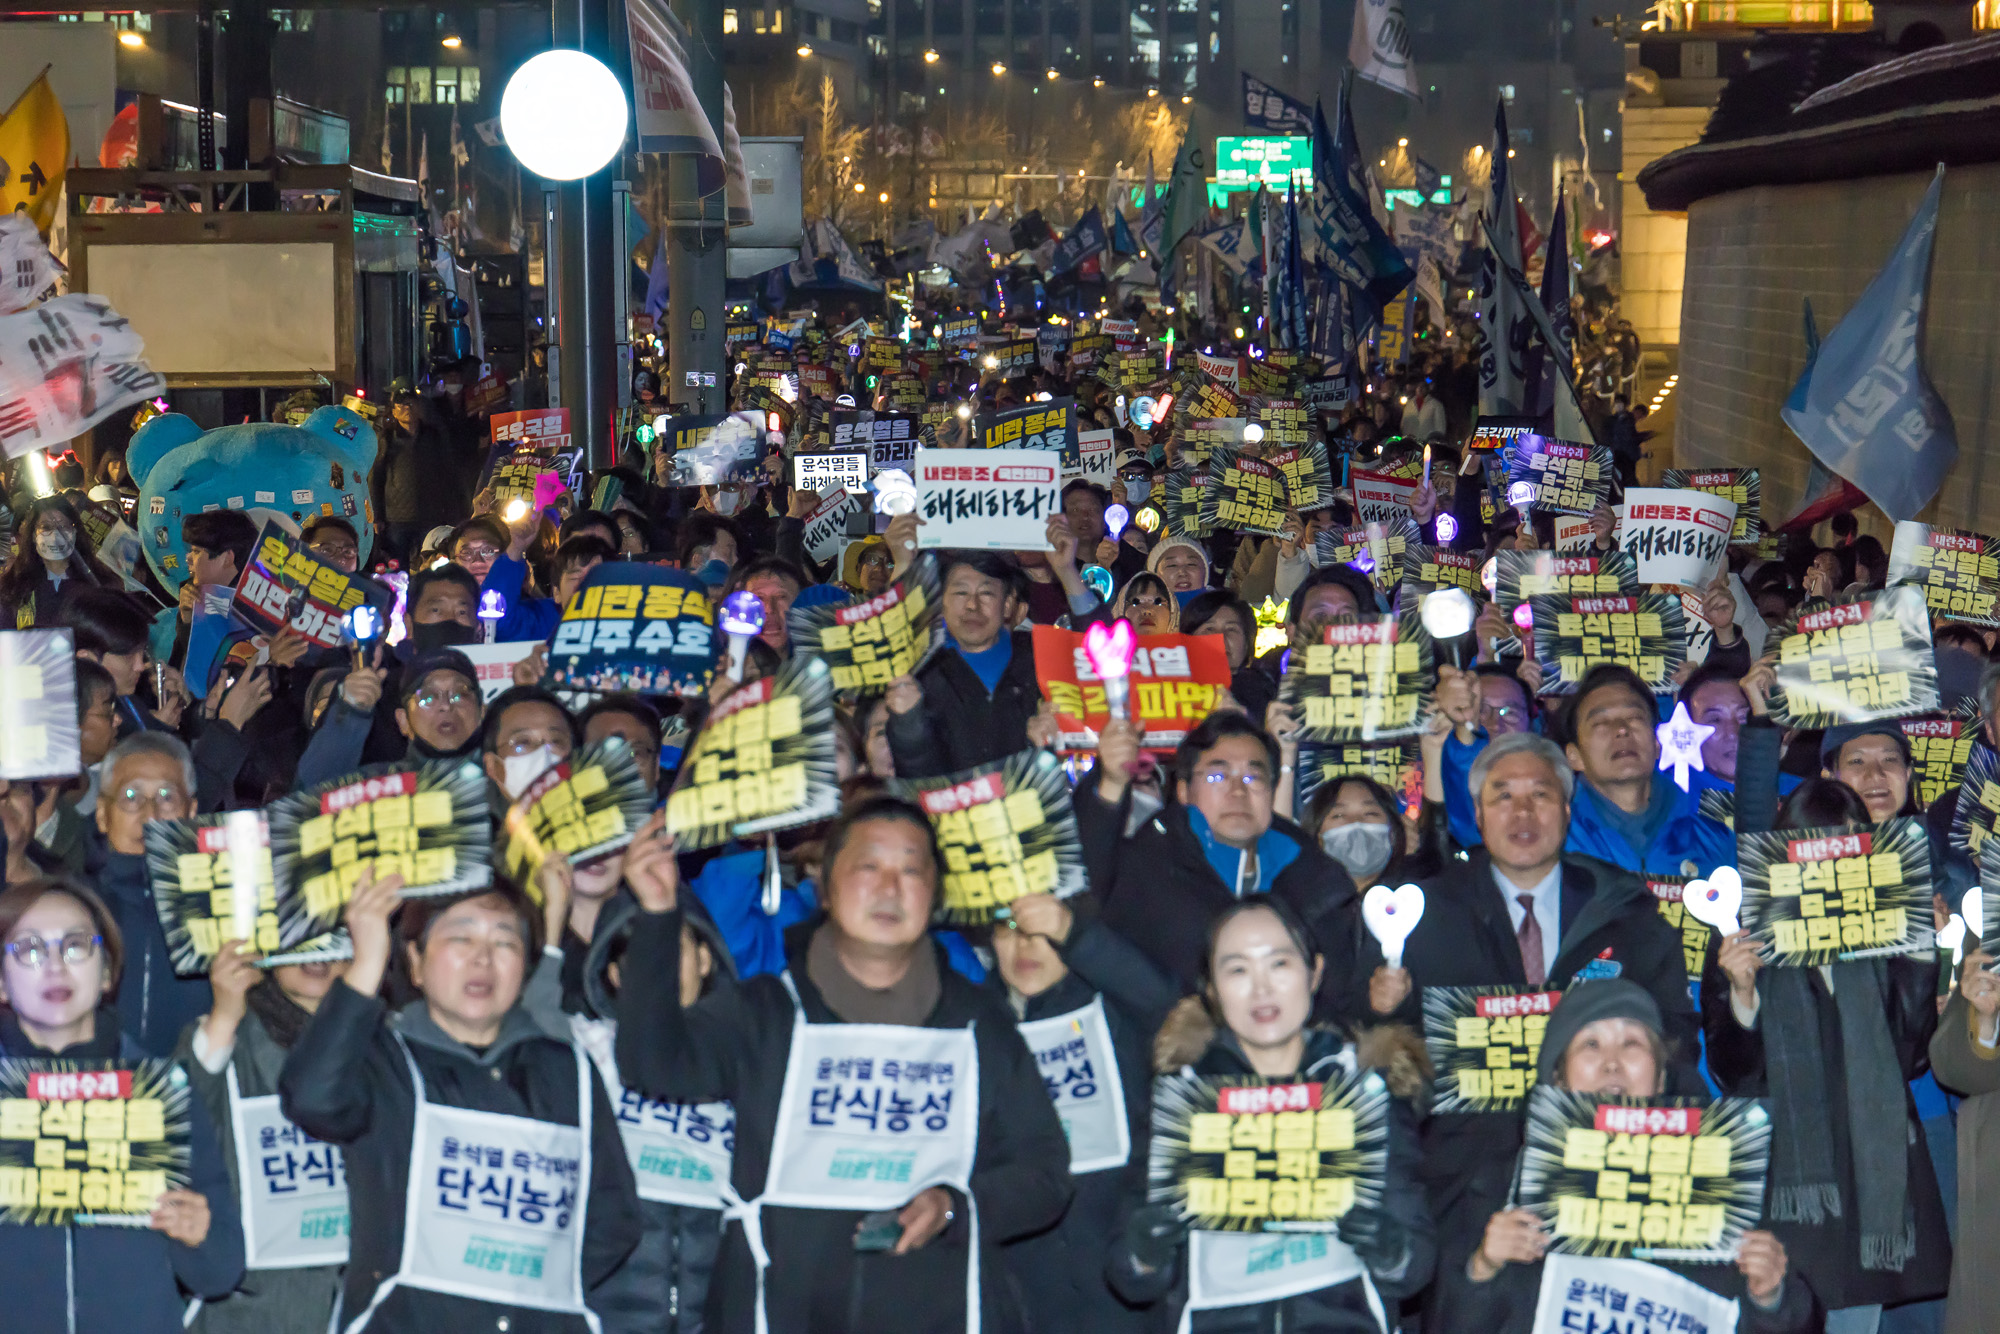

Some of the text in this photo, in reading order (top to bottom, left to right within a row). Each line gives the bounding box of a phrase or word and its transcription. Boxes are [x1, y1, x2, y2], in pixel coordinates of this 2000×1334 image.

[835, 419, 911, 444] 윤석열을
[986, 407, 1067, 449] 내란 종식
[802, 457, 860, 472] 윤석열들
[1241, 461, 1269, 475] 내란수괴
[1529, 452, 1600, 480] 윤석열을
[1550, 446, 1583, 459] 내란수괴
[924, 466, 1051, 481] 내란동조 국민의힘
[1224, 468, 1285, 499] 윤석열을
[923, 486, 1056, 524] 해체하라!
[1216, 500, 1285, 530] 파면하라
[1630, 505, 1692, 521] 내란동조
[1625, 525, 1727, 565] 해체하라!
[1936, 535, 1977, 551] 내란수괴
[256, 536, 364, 610] 윤석열을
[1439, 554, 1470, 568] 내란수괴
[1911, 544, 1998, 579] 윤석열을
[562, 585, 714, 627] 내란 종식
[842, 589, 898, 623] 내란수괴
[1578, 598, 1630, 613] 내란수괴
[1805, 602, 1863, 629] 내란수괴
[551, 620, 714, 657] 민주 수호
[1557, 613, 1663, 637] 윤석열을
[1780, 618, 1904, 665] 윤석열을
[1305, 642, 1420, 675] 윤석열을
[666, 761, 808, 834] 파면하라
[301, 790, 453, 858] 윤석열을
[1796, 834, 1861, 859] 내란수괴
[1769, 851, 1903, 898] 윤석열을
[1773, 906, 1909, 954] 파면하라
[1485, 991, 1551, 1015] 내란수괴
[816, 1056, 954, 1087] 윤석열 즉각파면
[808, 1085, 954, 1134] 단식농성
[1228, 1085, 1310, 1111] 내란수괴
[0, 1098, 166, 1142] 윤석열을
[1190, 1108, 1356, 1153] 윤석열을
[1606, 1108, 1688, 1132] 내란수괴
[440, 1136, 505, 1170] 윤석열
[1563, 1126, 1733, 1178] 윤석열을
[436, 1166, 577, 1231] 단식농성
[1186, 1176, 1356, 1219] 파면하라
[1556, 1194, 1726, 1244] 파면하라
[1566, 1277, 1629, 1313] 윤석열
